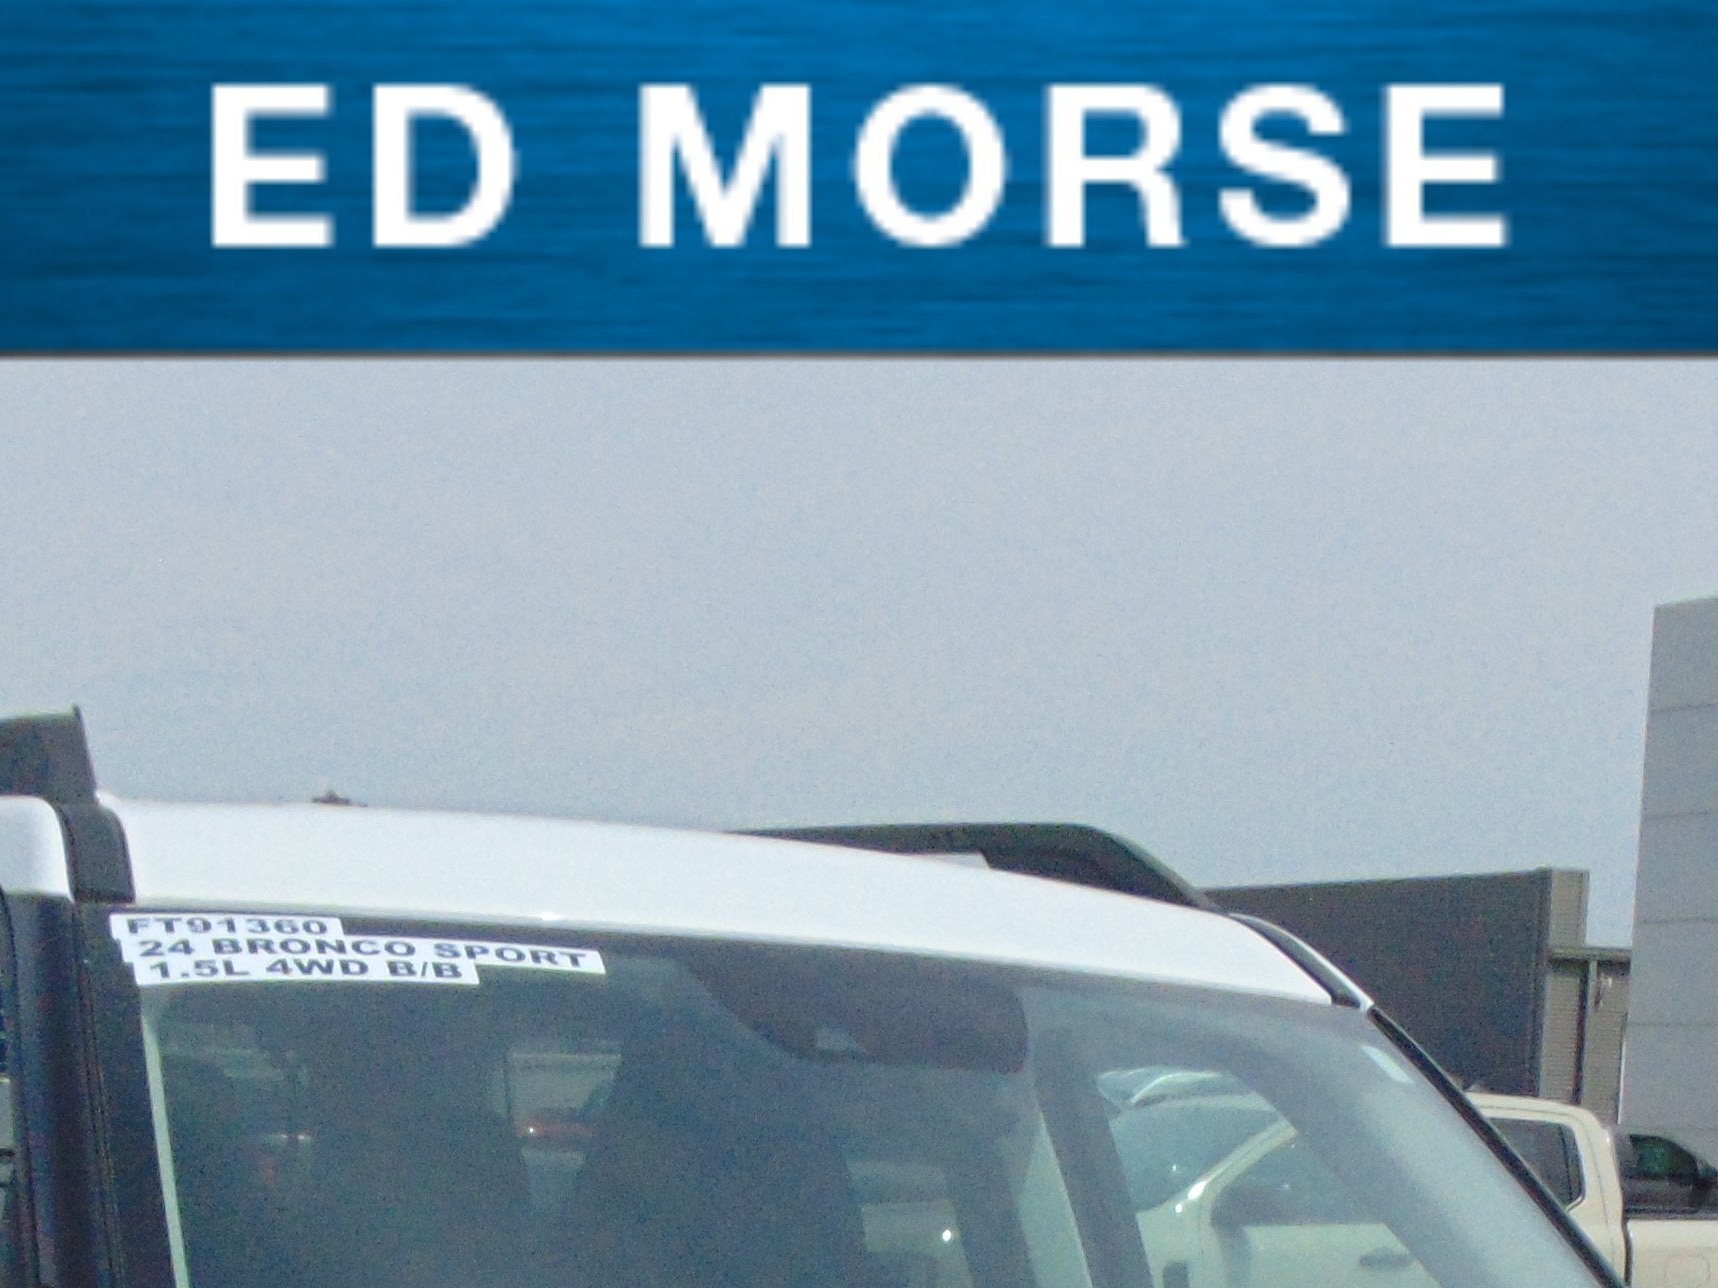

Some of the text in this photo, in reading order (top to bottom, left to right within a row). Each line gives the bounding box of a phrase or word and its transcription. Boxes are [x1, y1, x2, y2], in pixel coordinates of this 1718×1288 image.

[127, 917, 328, 935] FT91360
[139, 938, 587, 968] 24 BRONCO SPORT
[149, 960, 463, 979] 1.5L 4WD B/B
